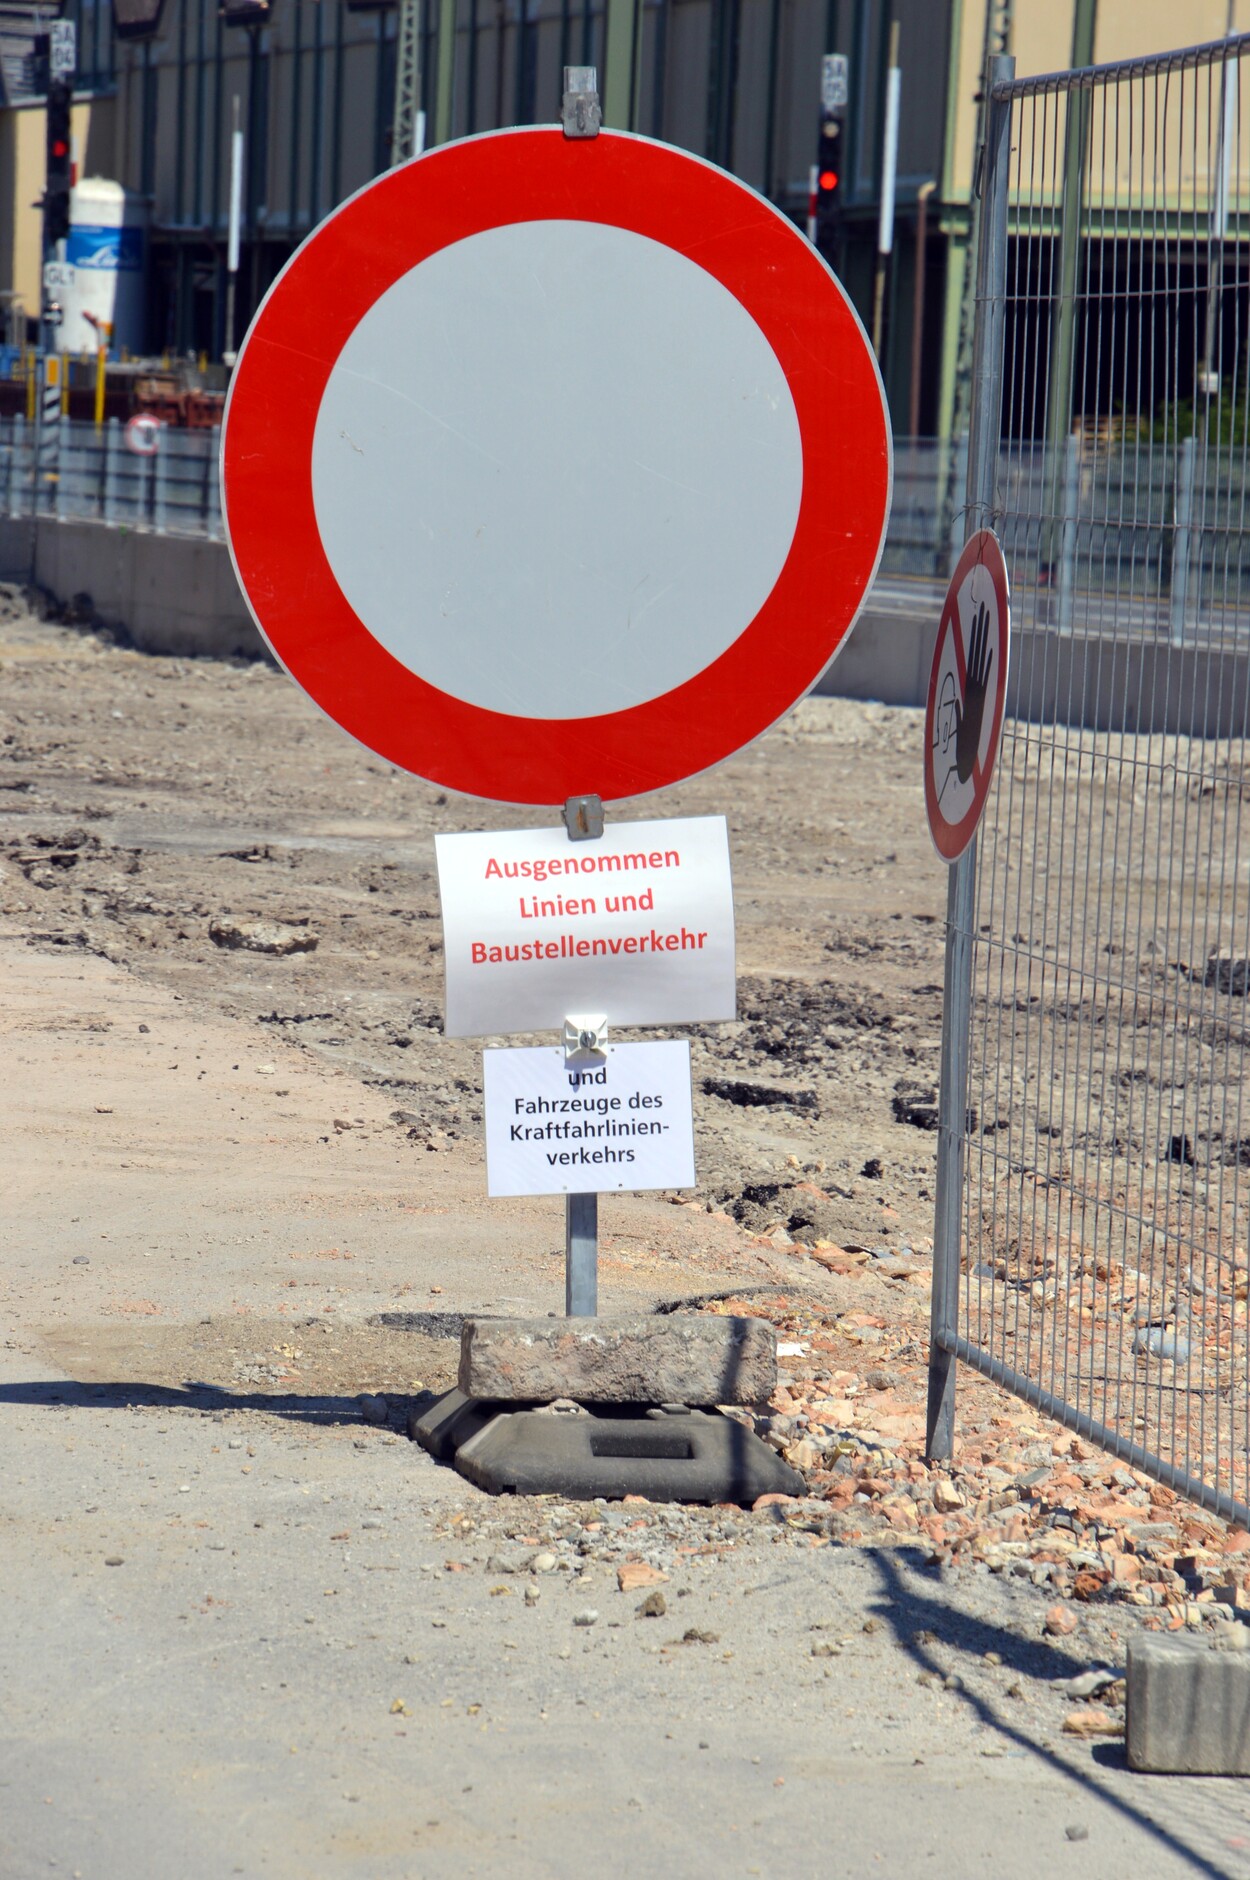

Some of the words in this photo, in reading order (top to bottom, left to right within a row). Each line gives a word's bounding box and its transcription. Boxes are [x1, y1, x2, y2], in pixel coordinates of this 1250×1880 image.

[485, 850, 680, 881] Ausgenommen
[519, 895, 597, 919] Linien
[605, 888, 654, 913] und
[471, 927, 708, 964] Baustellenverkehr
[568, 1067, 607, 1087] und
[514, 1096, 622, 1116] Fahrzeuge
[628, 1091, 663, 1110] des
[510, 1119, 670, 1141] Kraftfahrlinien-
[546, 1145, 635, 1166] verkehrs
